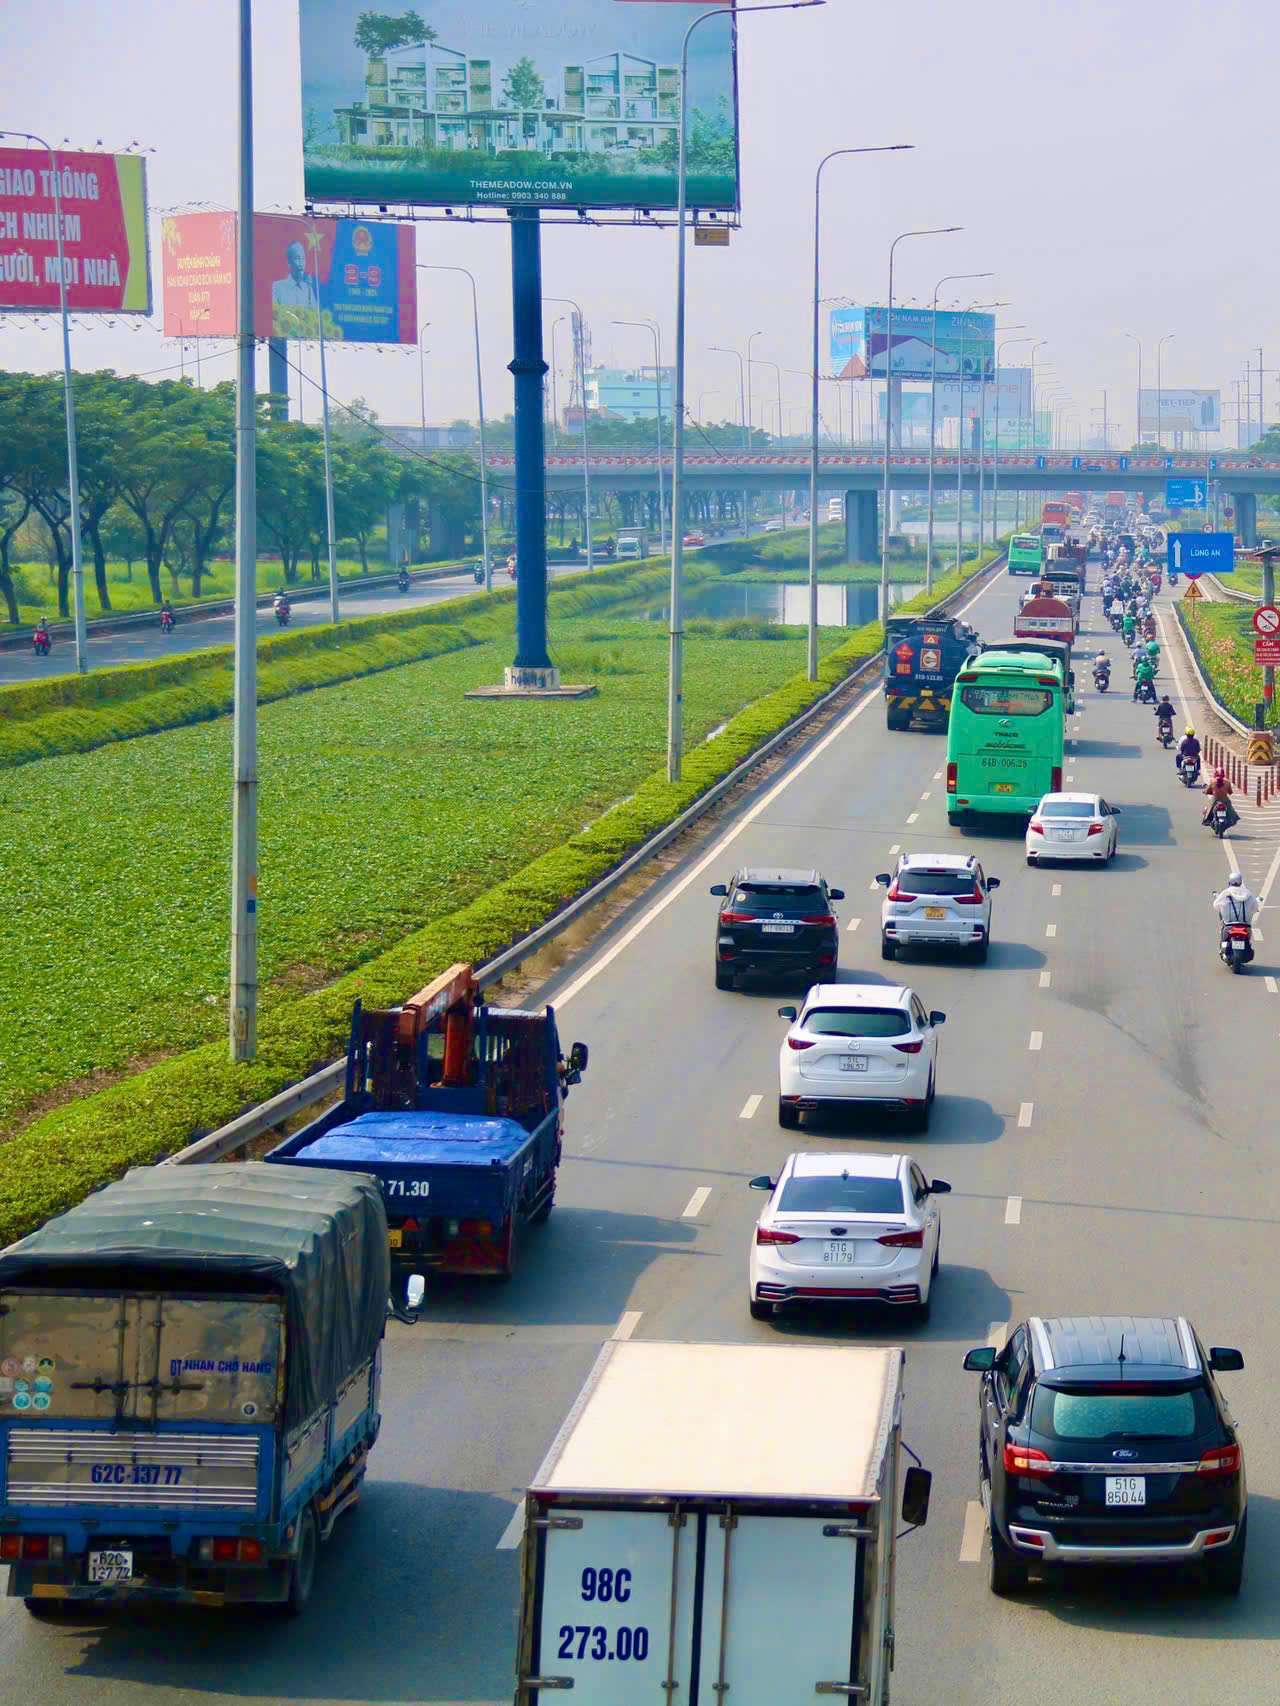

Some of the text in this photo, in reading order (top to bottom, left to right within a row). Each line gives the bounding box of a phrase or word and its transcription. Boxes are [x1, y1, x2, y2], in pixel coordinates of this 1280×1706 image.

[40, 166, 99, 200] THÔNG
[470, 180, 573, 190] THEMEADOW.COM.VN
[477, 191, 510, 200] Hotline:
[511, 192, 532, 200] 0903
[534, 192, 550, 200] 340
[44, 255, 79, 290] MỌI
[84, 253, 121, 286] NHÀ
[944, 383, 1019, 393] mobone
[1190, 549, 1221, 557] LONG AN
[830, 1242, 847, 1252] 51G
[1115, 1478, 1136, 1491] 51G
[1107, 1491, 1144, 1505] 850.44
[581, 1566, 632, 1603] 98C
[557, 1624, 649, 1661] 273.00
